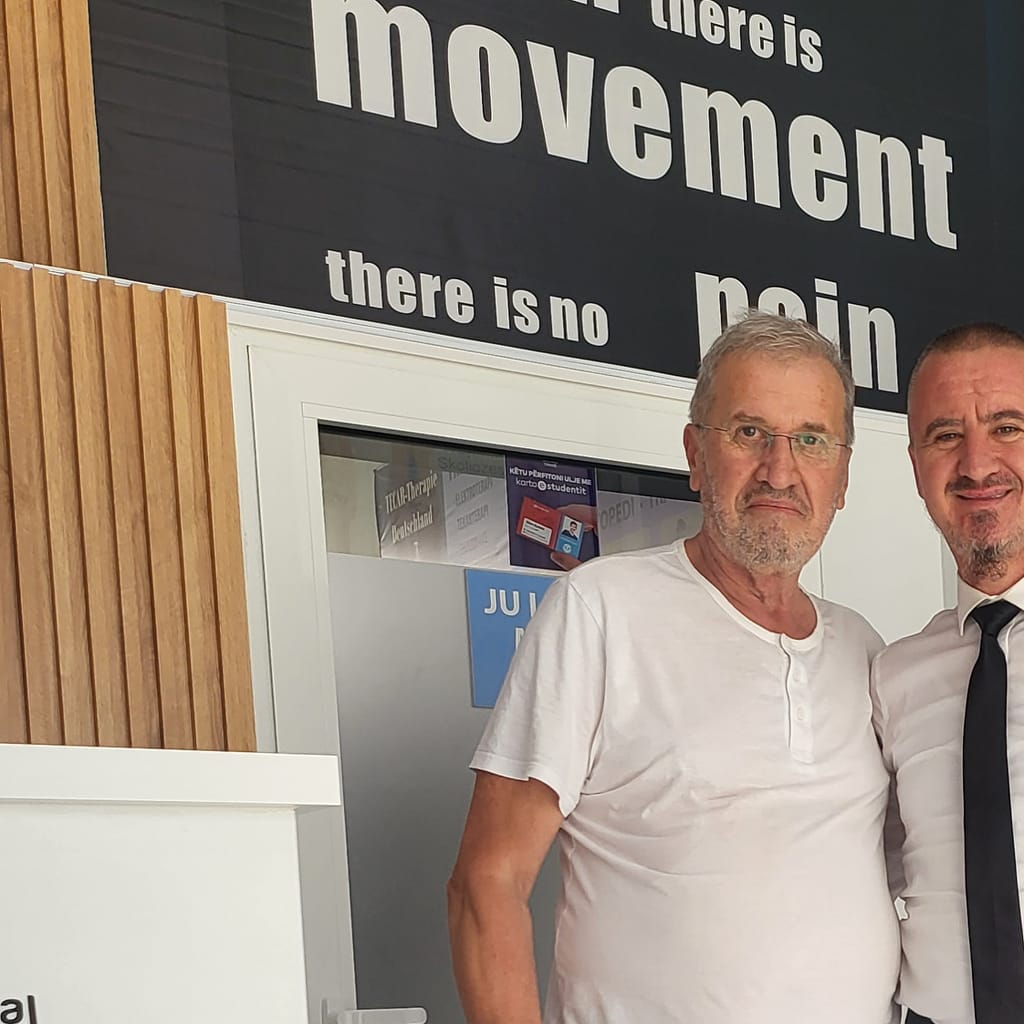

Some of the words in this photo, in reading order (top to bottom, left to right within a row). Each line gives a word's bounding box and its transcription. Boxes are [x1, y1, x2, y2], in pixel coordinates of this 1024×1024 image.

[651, 0, 774, 59] there
[783, 14, 823, 73] is
[311, 0, 957, 250] movement
[325, 249, 475, 324] there
[493, 276, 540, 334] is
[550, 295, 609, 346] no
[484, 588, 520, 616] JU
